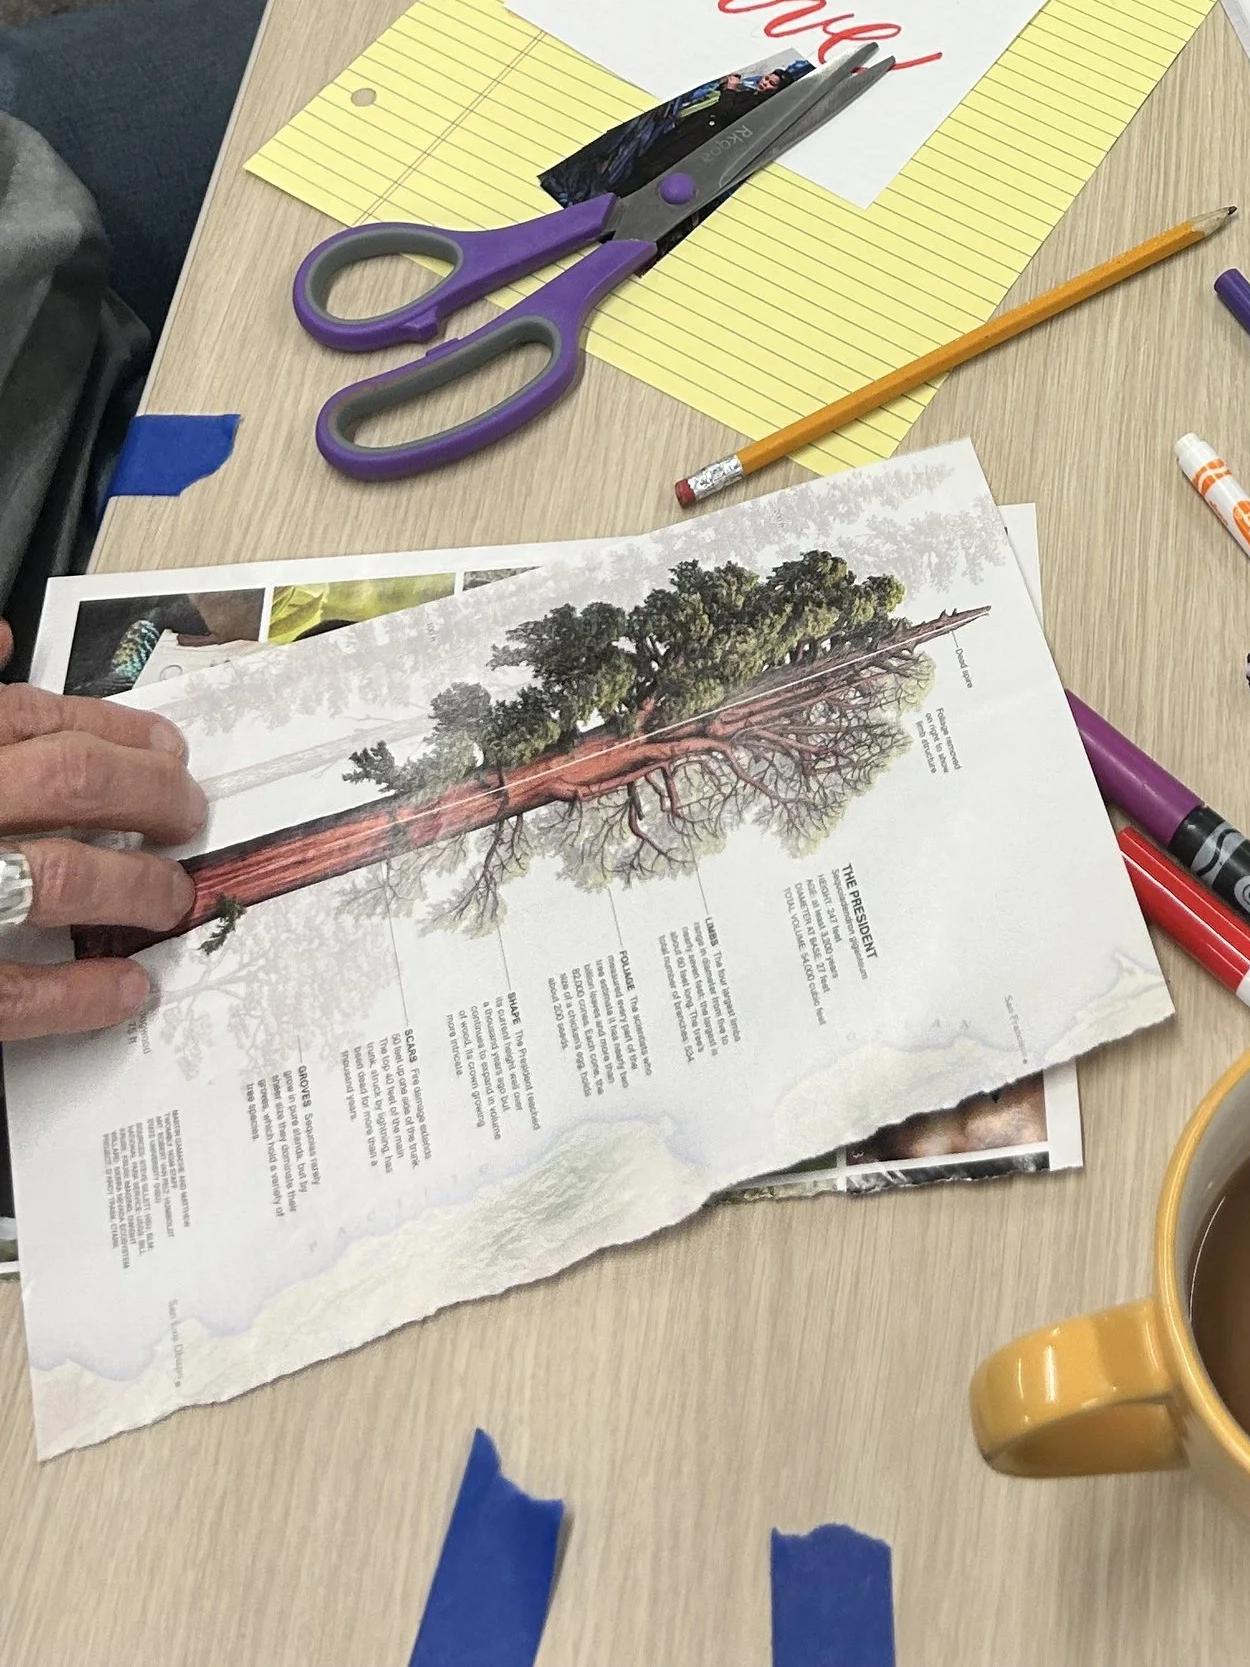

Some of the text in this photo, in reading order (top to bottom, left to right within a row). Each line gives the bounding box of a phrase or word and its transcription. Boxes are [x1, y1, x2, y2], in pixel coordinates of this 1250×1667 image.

[955, 648, 973, 689] Dead spire
[936, 707, 962, 770] Foliage removed
[831, 868, 868, 980] Sequoiadendron giganteum
[842, 863, 878, 958] THE PRESIDENT
[619, 950, 653, 1076] FOLIAGE The scientists who
[705, 917, 741, 1043] LIMBS The four largest limbs
[404, 1028, 432, 1160] SCARS Fire damage extends
[507, 992, 541, 1131] SHAPE The President reached
[298, 1065, 321, 1185] GROVES Sequoias rarely
